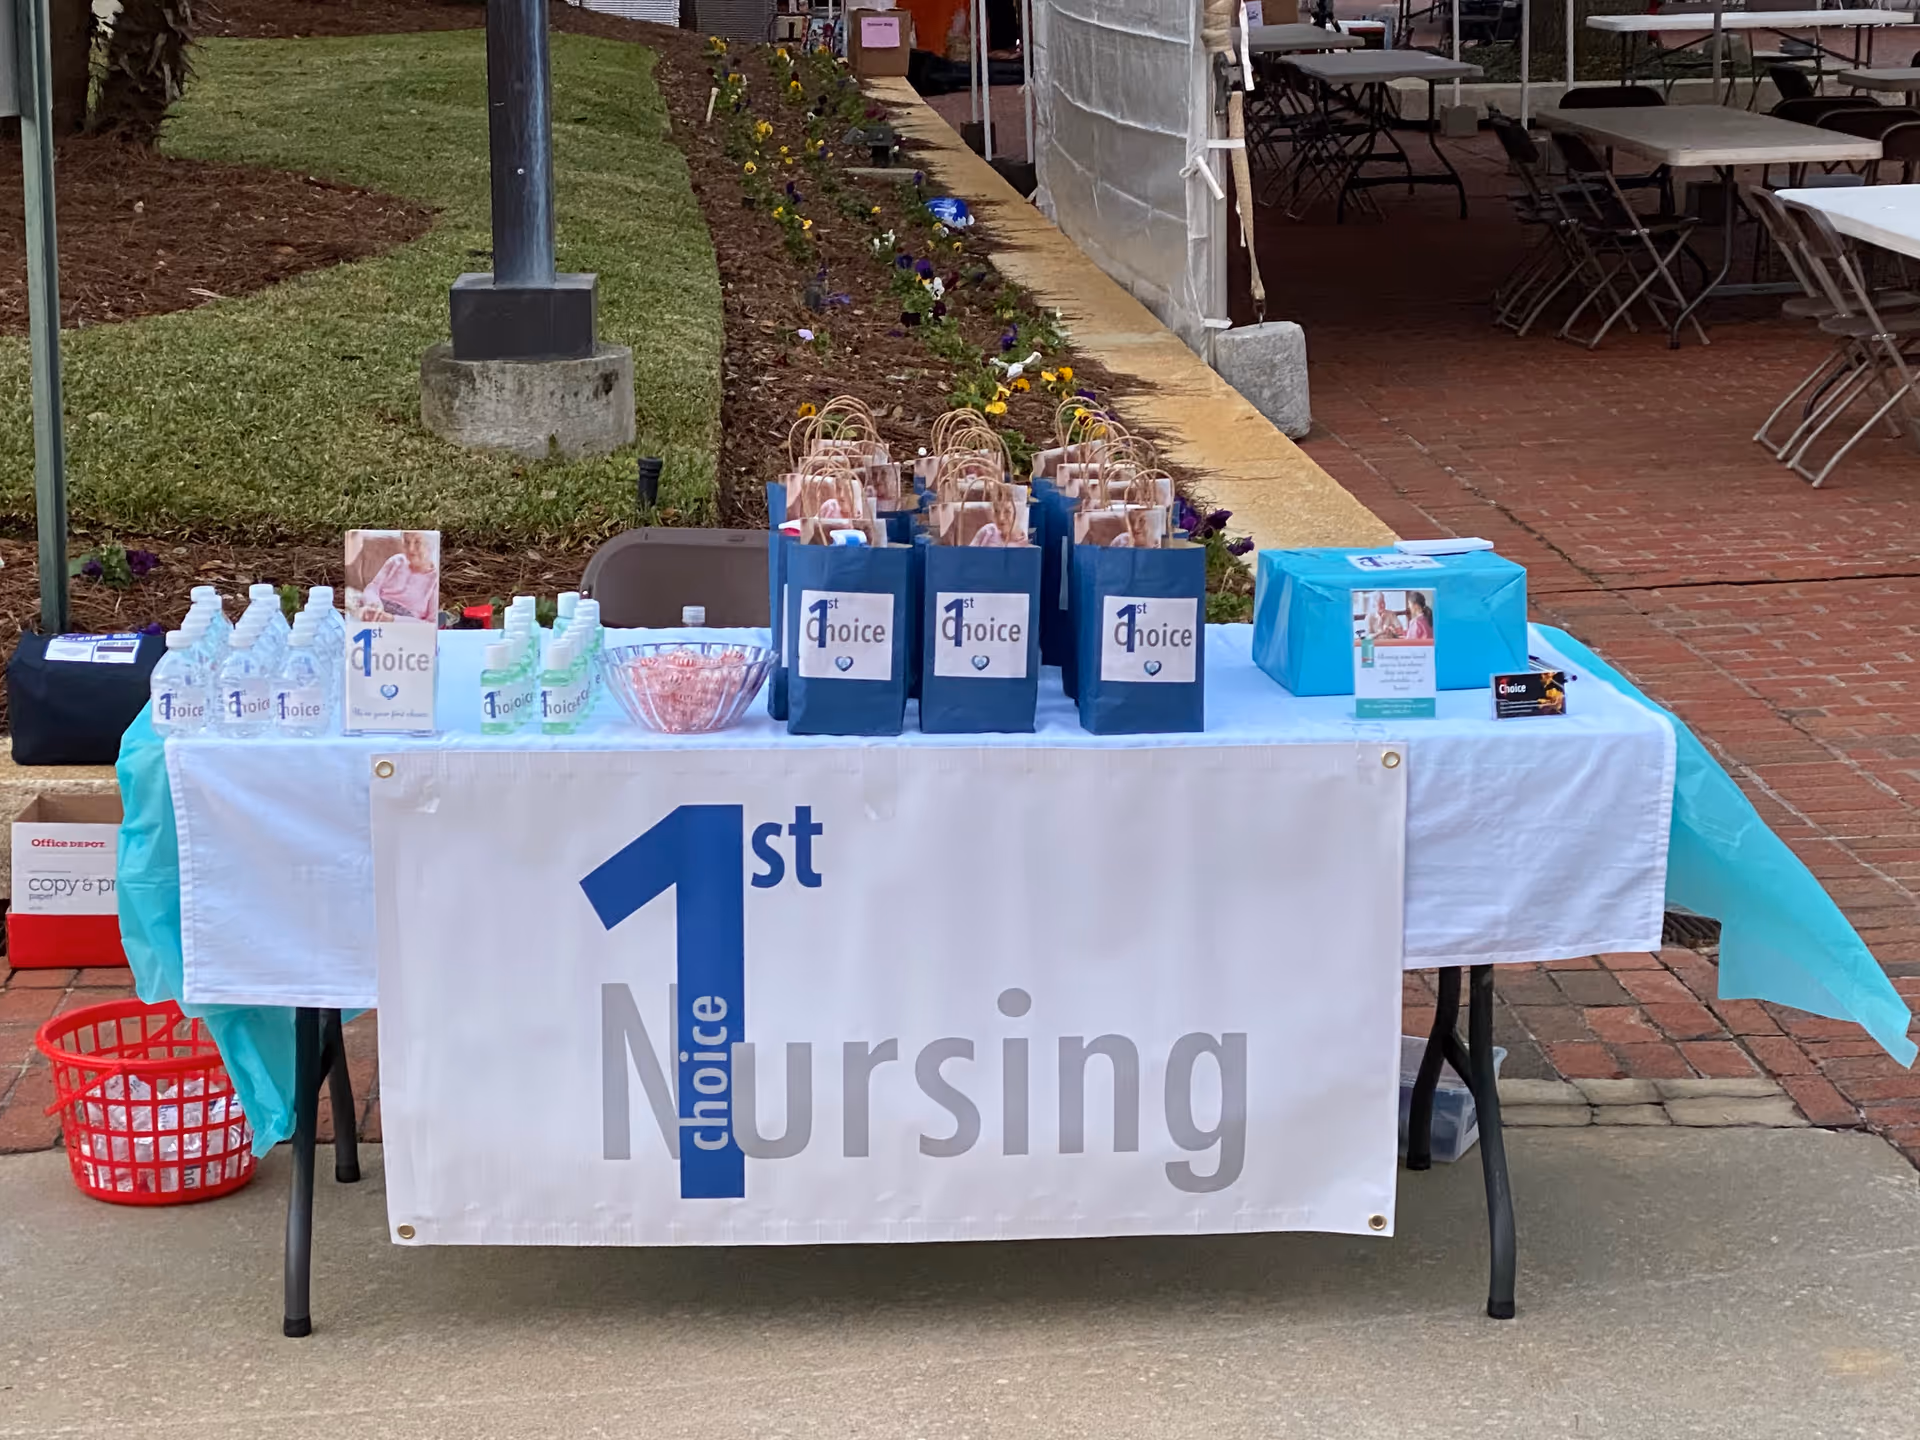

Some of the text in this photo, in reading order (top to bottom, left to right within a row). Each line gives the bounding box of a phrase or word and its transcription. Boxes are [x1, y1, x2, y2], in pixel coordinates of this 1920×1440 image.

[806, 617, 885, 643] Choice
[809, 597, 839, 648] 1st
[942, 616, 1021, 642] Choice
[944, 597, 974, 647] 1st
[1114, 621, 1192, 647] Choice
[1116, 602, 1147, 653] 1st
[351, 646, 429, 671] Choice
[353, 627, 383, 677] 1st
[1499, 683, 1526, 694] Choice
[31, 838, 68, 848] Office
[28, 877, 116, 896] copy & pr
[580, 803, 824, 1199] 1st
[600, 982, 1249, 1195] Nursing
[678, 995, 728, 1152] choice
